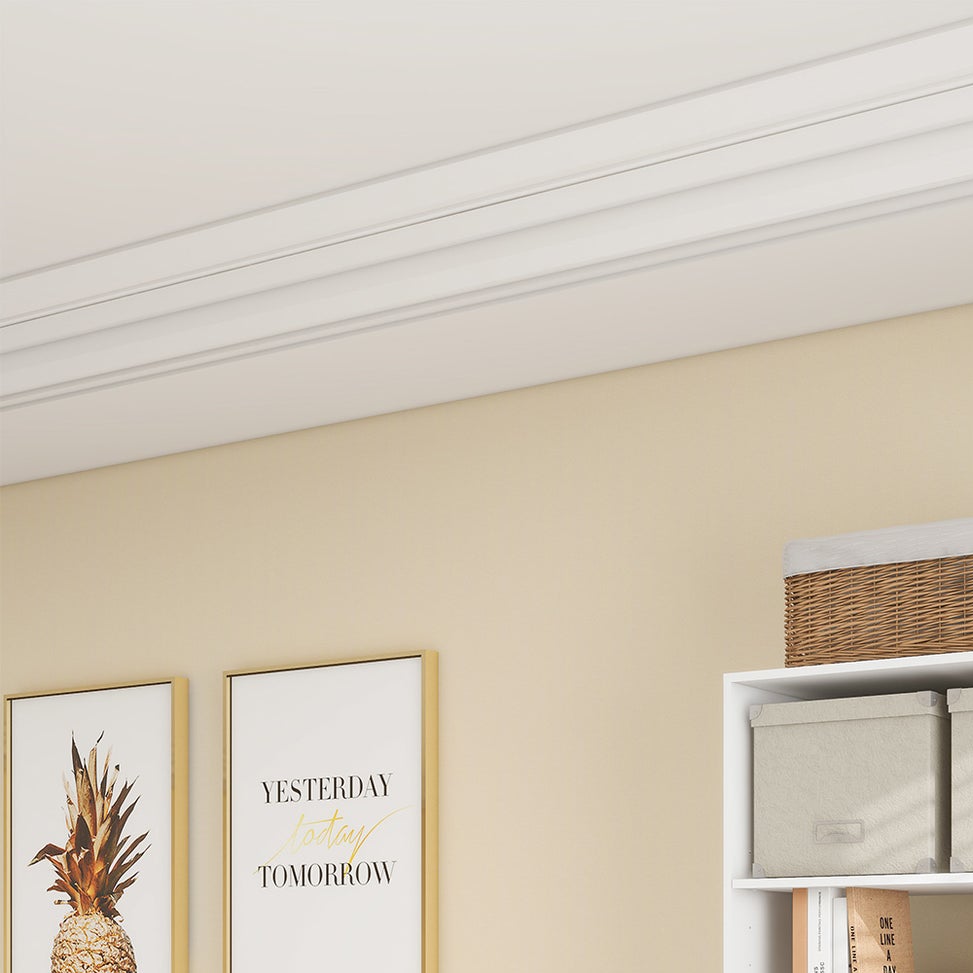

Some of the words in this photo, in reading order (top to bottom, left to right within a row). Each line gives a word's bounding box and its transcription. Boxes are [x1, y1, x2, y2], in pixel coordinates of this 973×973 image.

[260, 773, 393, 804] YESTERDAY
[253, 805, 416, 876] today
[257, 860, 397, 888] TOMORROW
[879, 917, 893, 930] ONE
[880, 933, 896, 946] LINE
[886, 950, 892, 962] A
